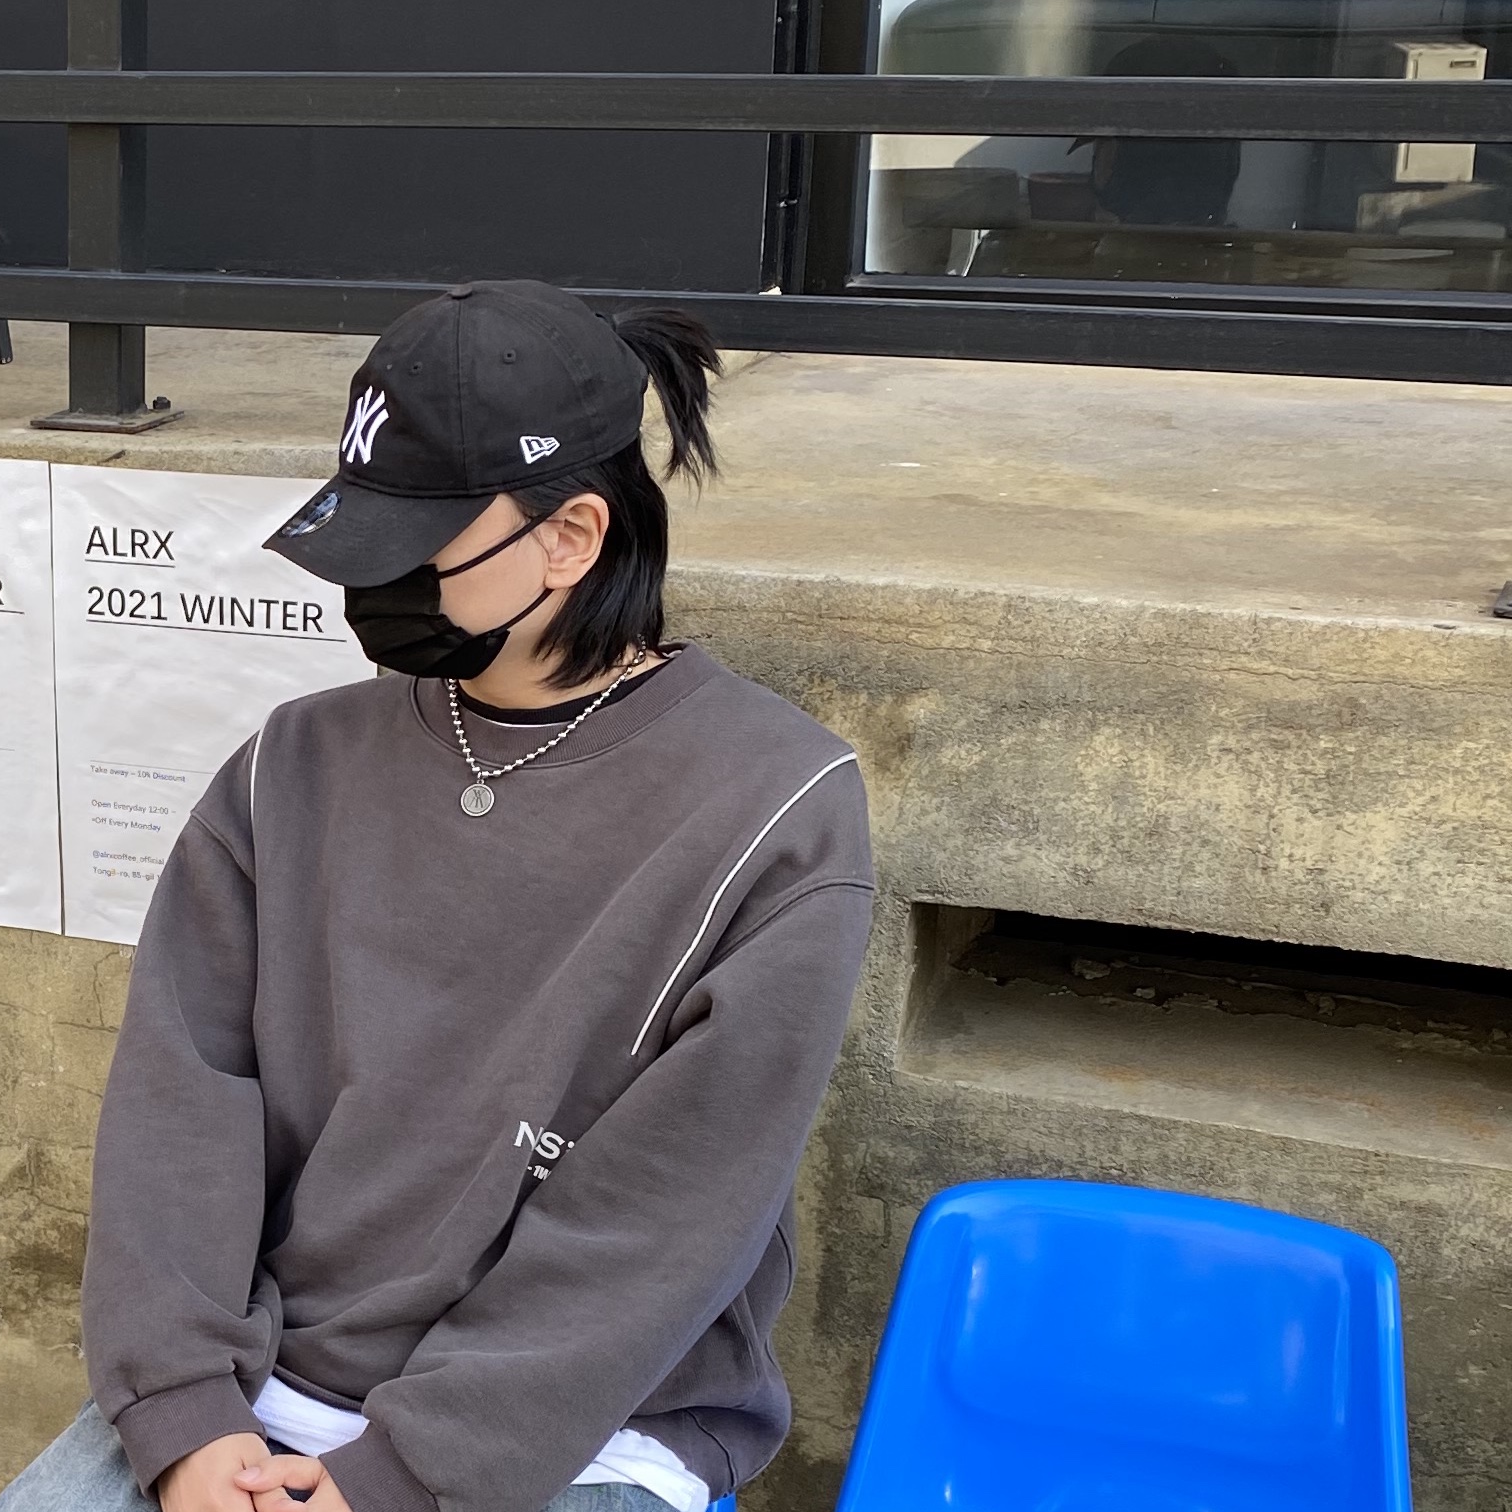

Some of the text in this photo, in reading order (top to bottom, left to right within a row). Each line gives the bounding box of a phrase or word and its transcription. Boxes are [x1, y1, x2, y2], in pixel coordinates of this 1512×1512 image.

[85, 525, 175, 561] ALRX
[87, 585, 325, 634] 2021 WINTER
[90, 764, 108, 773] Take
[152, 772, 186, 782] Discount
[91, 799, 112, 809] Open
[113, 801, 147, 815] Everyday
[108, 818, 129, 829] Every
[130, 820, 161, 832] Monday
